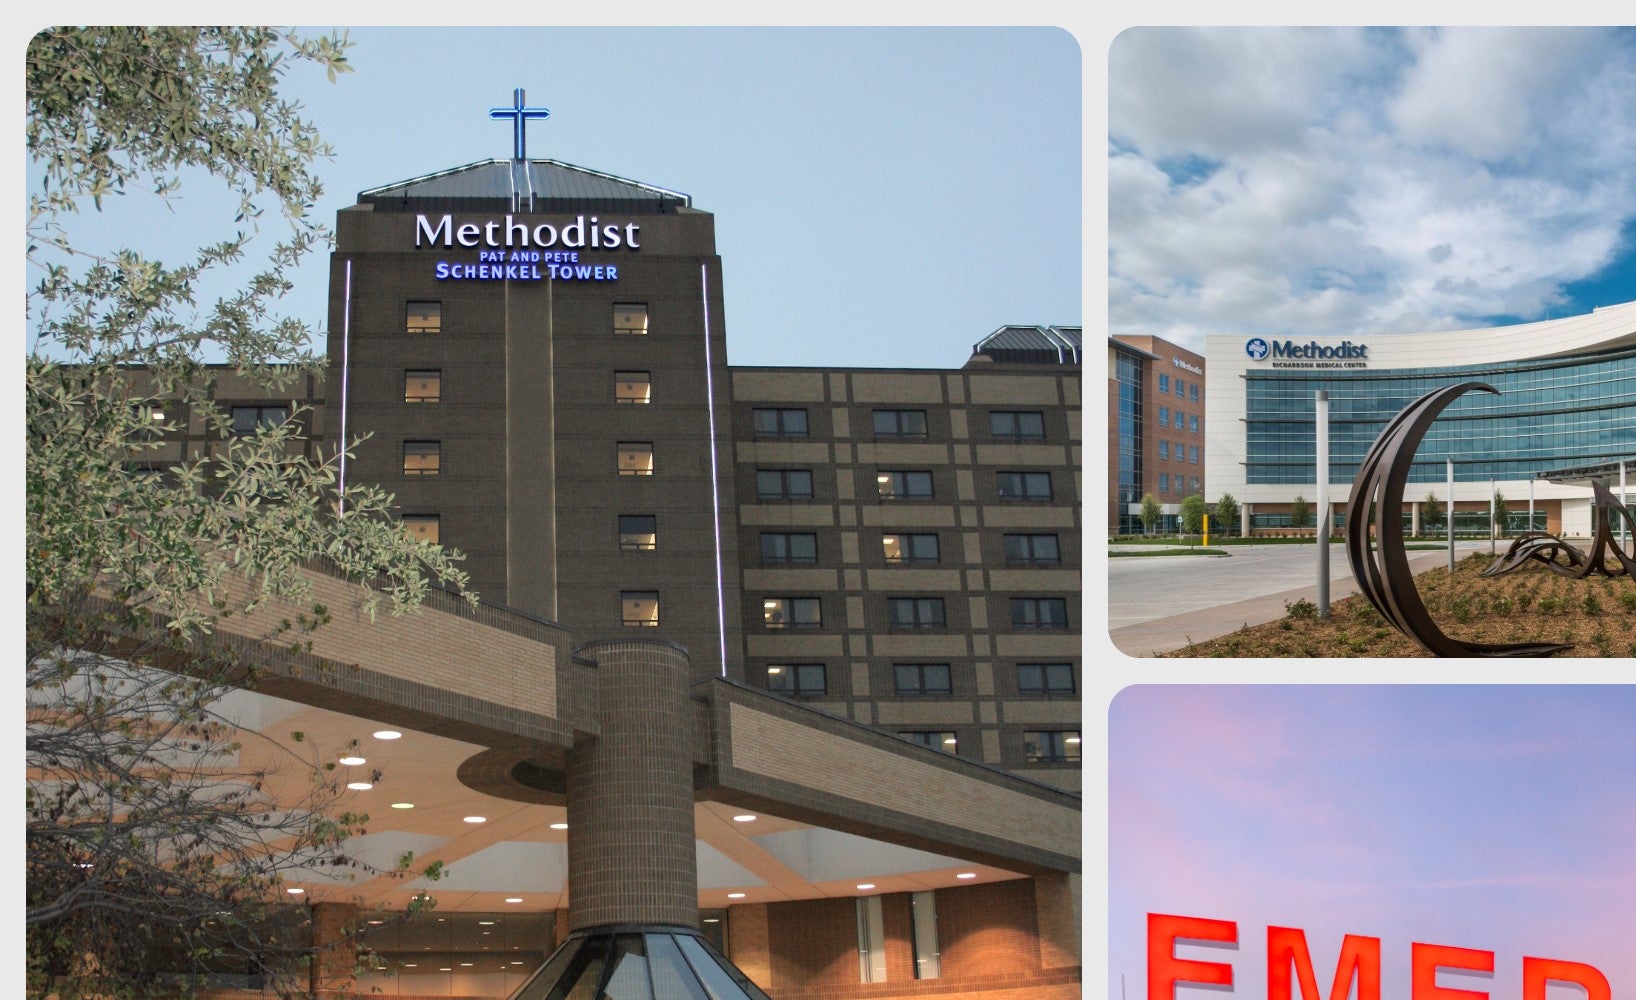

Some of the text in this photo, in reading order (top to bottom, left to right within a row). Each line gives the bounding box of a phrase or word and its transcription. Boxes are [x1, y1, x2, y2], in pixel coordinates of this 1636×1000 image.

[416, 214, 641, 248] Methodist
[480, 251, 579, 263] PAT AND PETE
[436, 262, 618, 280] SCHENKEL TOWER
[1273, 340, 1368, 358] Methodist
